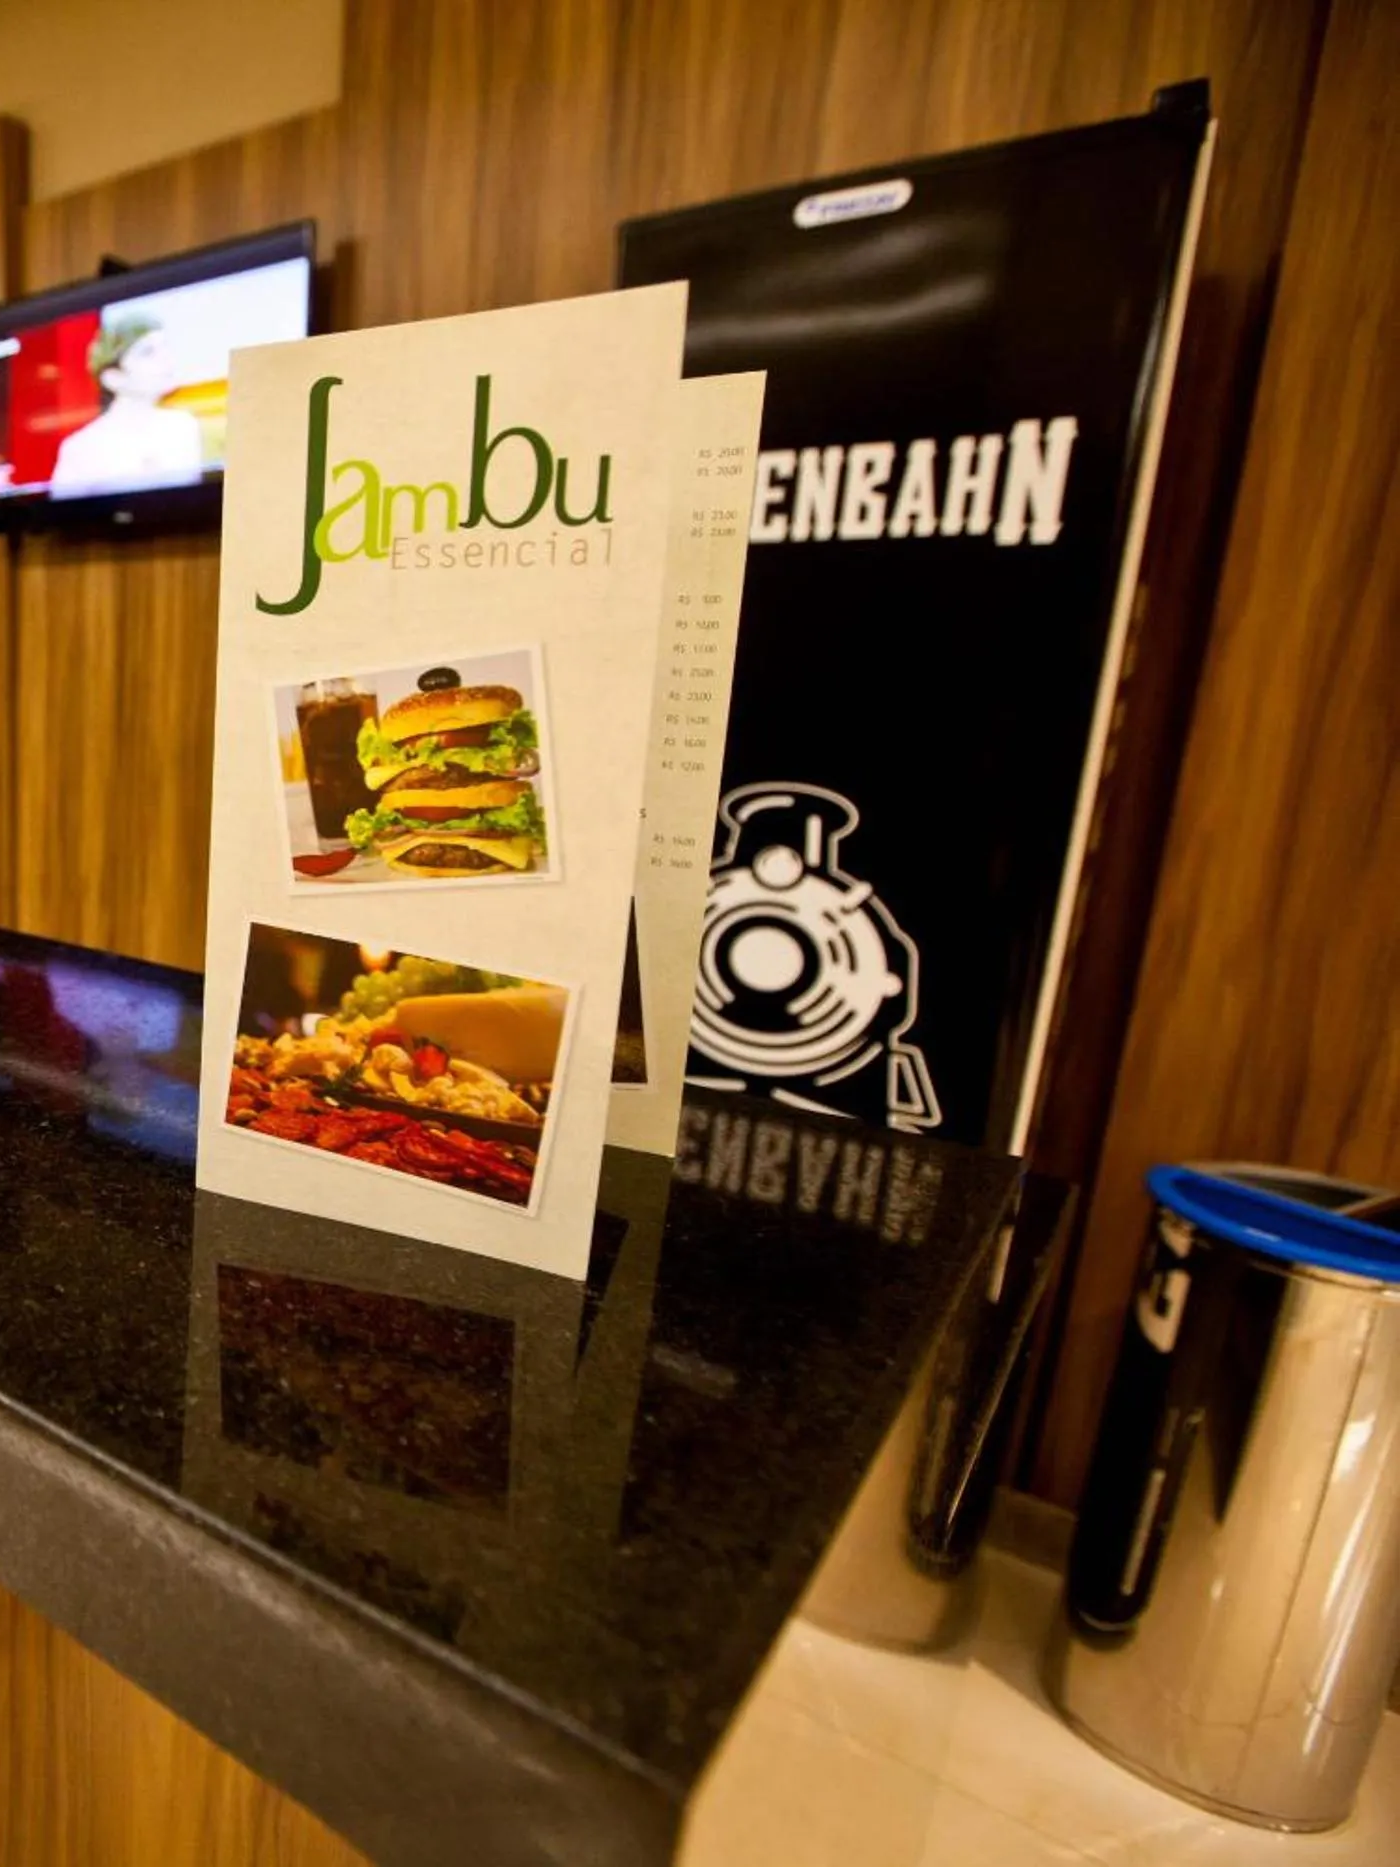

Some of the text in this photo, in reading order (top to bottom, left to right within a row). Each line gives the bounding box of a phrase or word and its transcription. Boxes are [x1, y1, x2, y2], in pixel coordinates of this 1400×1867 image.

[256, 375, 613, 615] Jambu
[749, 415, 1078, 547] ENBAHN
[391, 528, 613, 571] Essencial
